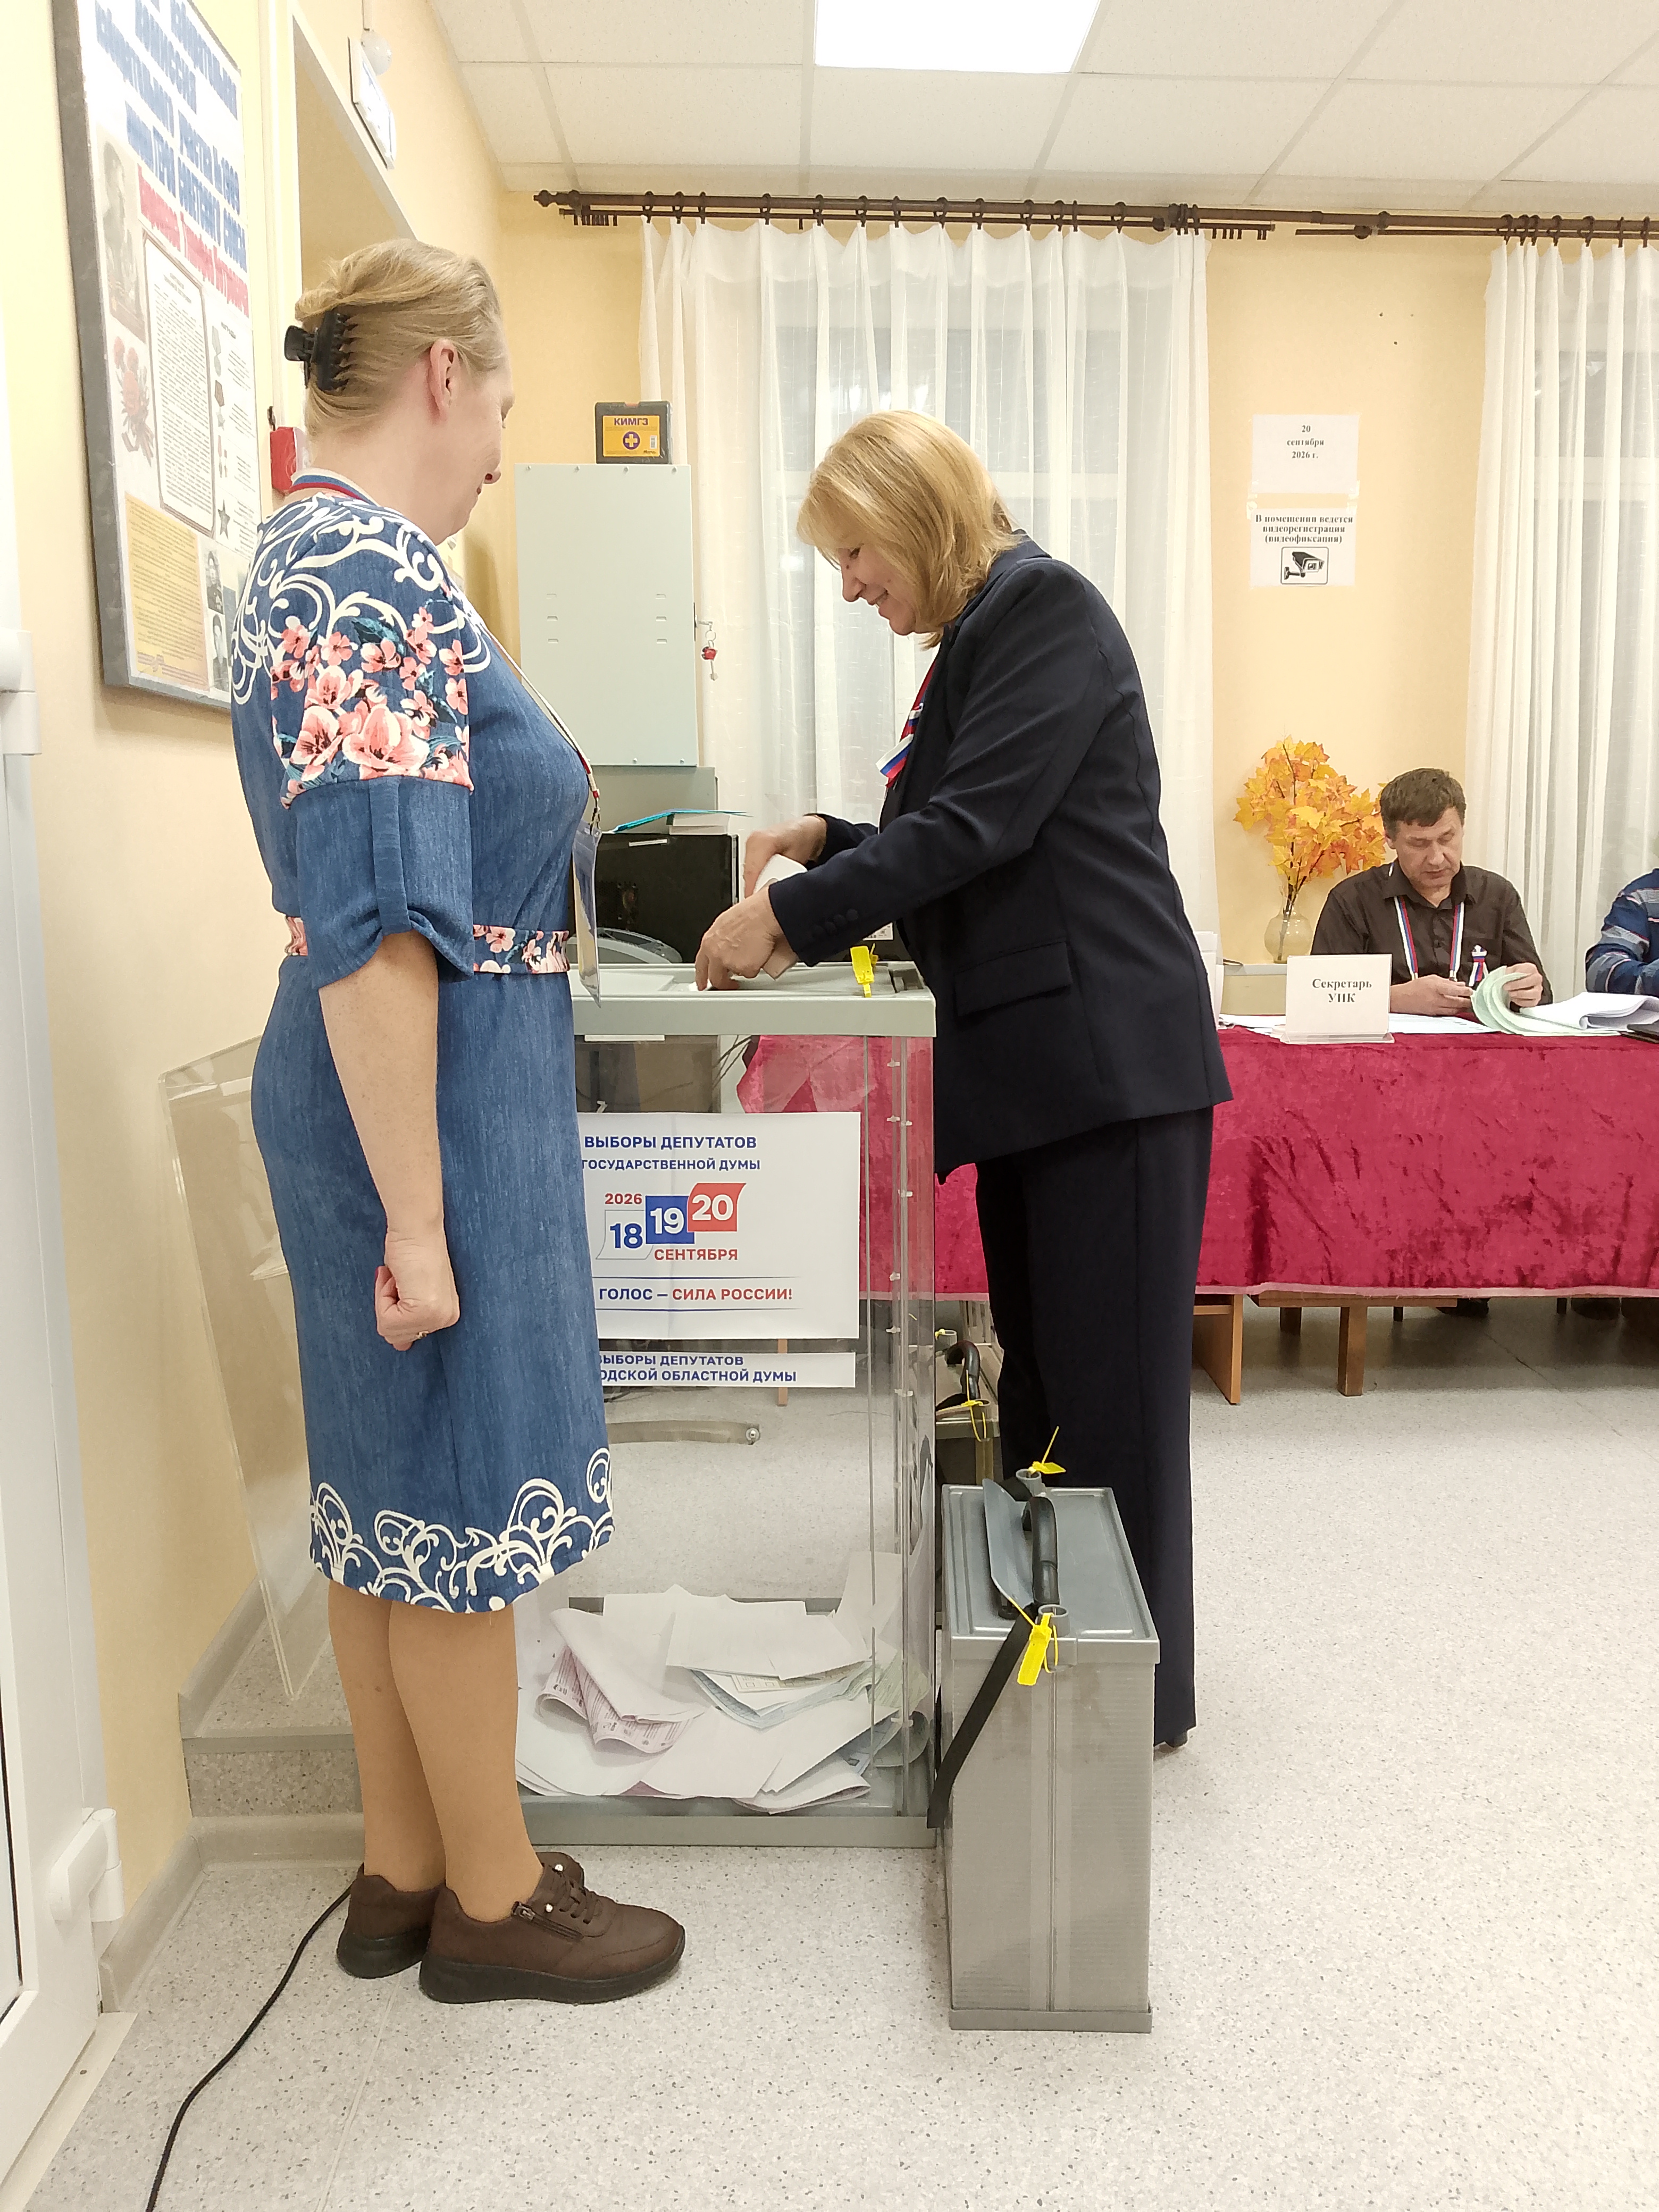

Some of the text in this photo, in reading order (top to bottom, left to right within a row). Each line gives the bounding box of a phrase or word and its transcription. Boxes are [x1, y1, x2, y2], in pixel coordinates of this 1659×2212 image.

[614, 417, 648, 426] КИМГЗ
[1287, 438, 1324, 448] сентября
[1255, 514, 1262, 523] В
[1263, 526, 1345, 534] видеорегистрация
[1265, 534, 1342, 544] (видеофиксация)
[1312, 978, 1372, 991] Секретарь
[1328, 993, 1356, 1003] УИК
[584, 1136, 757, 1150] ВЫБОРЫ ДЕПУТАТОВ
[582, 1157, 760, 1171] ГОСУДАРСТВЕННОЙ ДУМЫ
[605, 1193, 642, 1205] 2026
[610, 1194, 734, 1249] 18 19 20
[654, 1249, 738, 1260] СЕНТЯБРЯ
[599, 1288, 653, 1300] ГОЛОС
[672, 1288, 716, 1300] СИЛА
[721, 1288, 792, 1300] РОССИИ!
[599, 1354, 744, 1367] ЫБОРЫ ДЕПУТАТОВ
[661, 1368, 749, 1381] ОБЛАСТНОЙ
[752, 1371, 797, 1383] ДУМЫ
